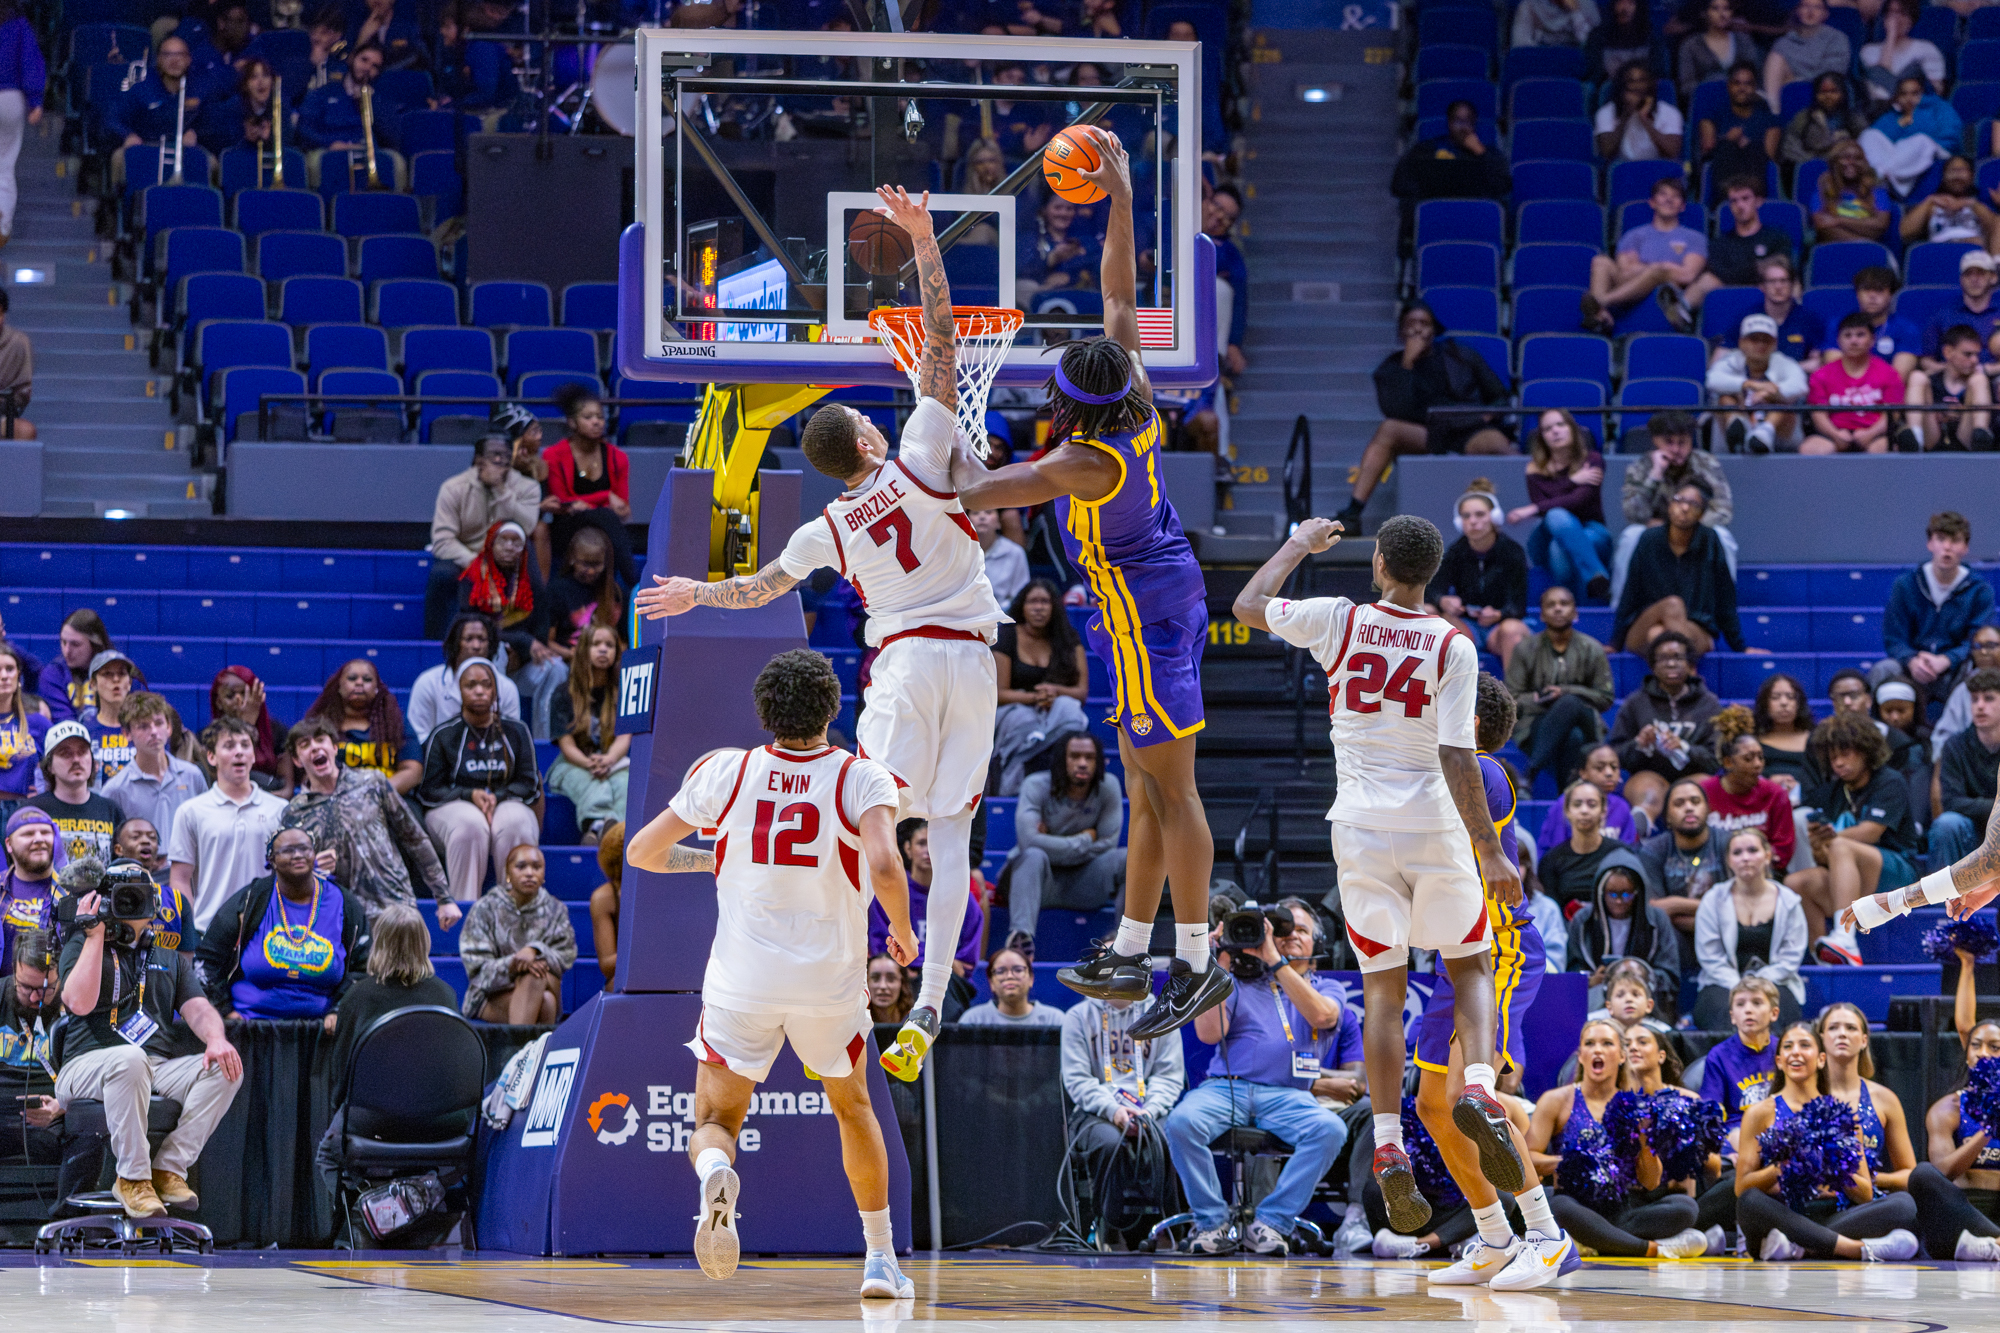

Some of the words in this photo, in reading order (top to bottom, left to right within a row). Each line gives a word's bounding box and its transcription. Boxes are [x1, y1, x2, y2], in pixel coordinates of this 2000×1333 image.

[661, 345, 716, 358] SPALDING
[1146, 450, 1160, 509] 1
[1230, 465, 1270, 484] 26
[843, 479, 907, 533] BRAZILE
[865, 505, 922, 575] 7
[1207, 620, 1251, 646] 119
[1356, 623, 1423, 651] RICHMOND
[1421, 633, 1437, 653] III
[619, 661, 655, 717] YETI
[1345, 651, 1432, 719] 24
[101, 733, 129, 749] LSU
[767, 769, 812, 795] EWIN
[751, 798, 821, 869] 12
[646, 1121, 761, 1153] She
